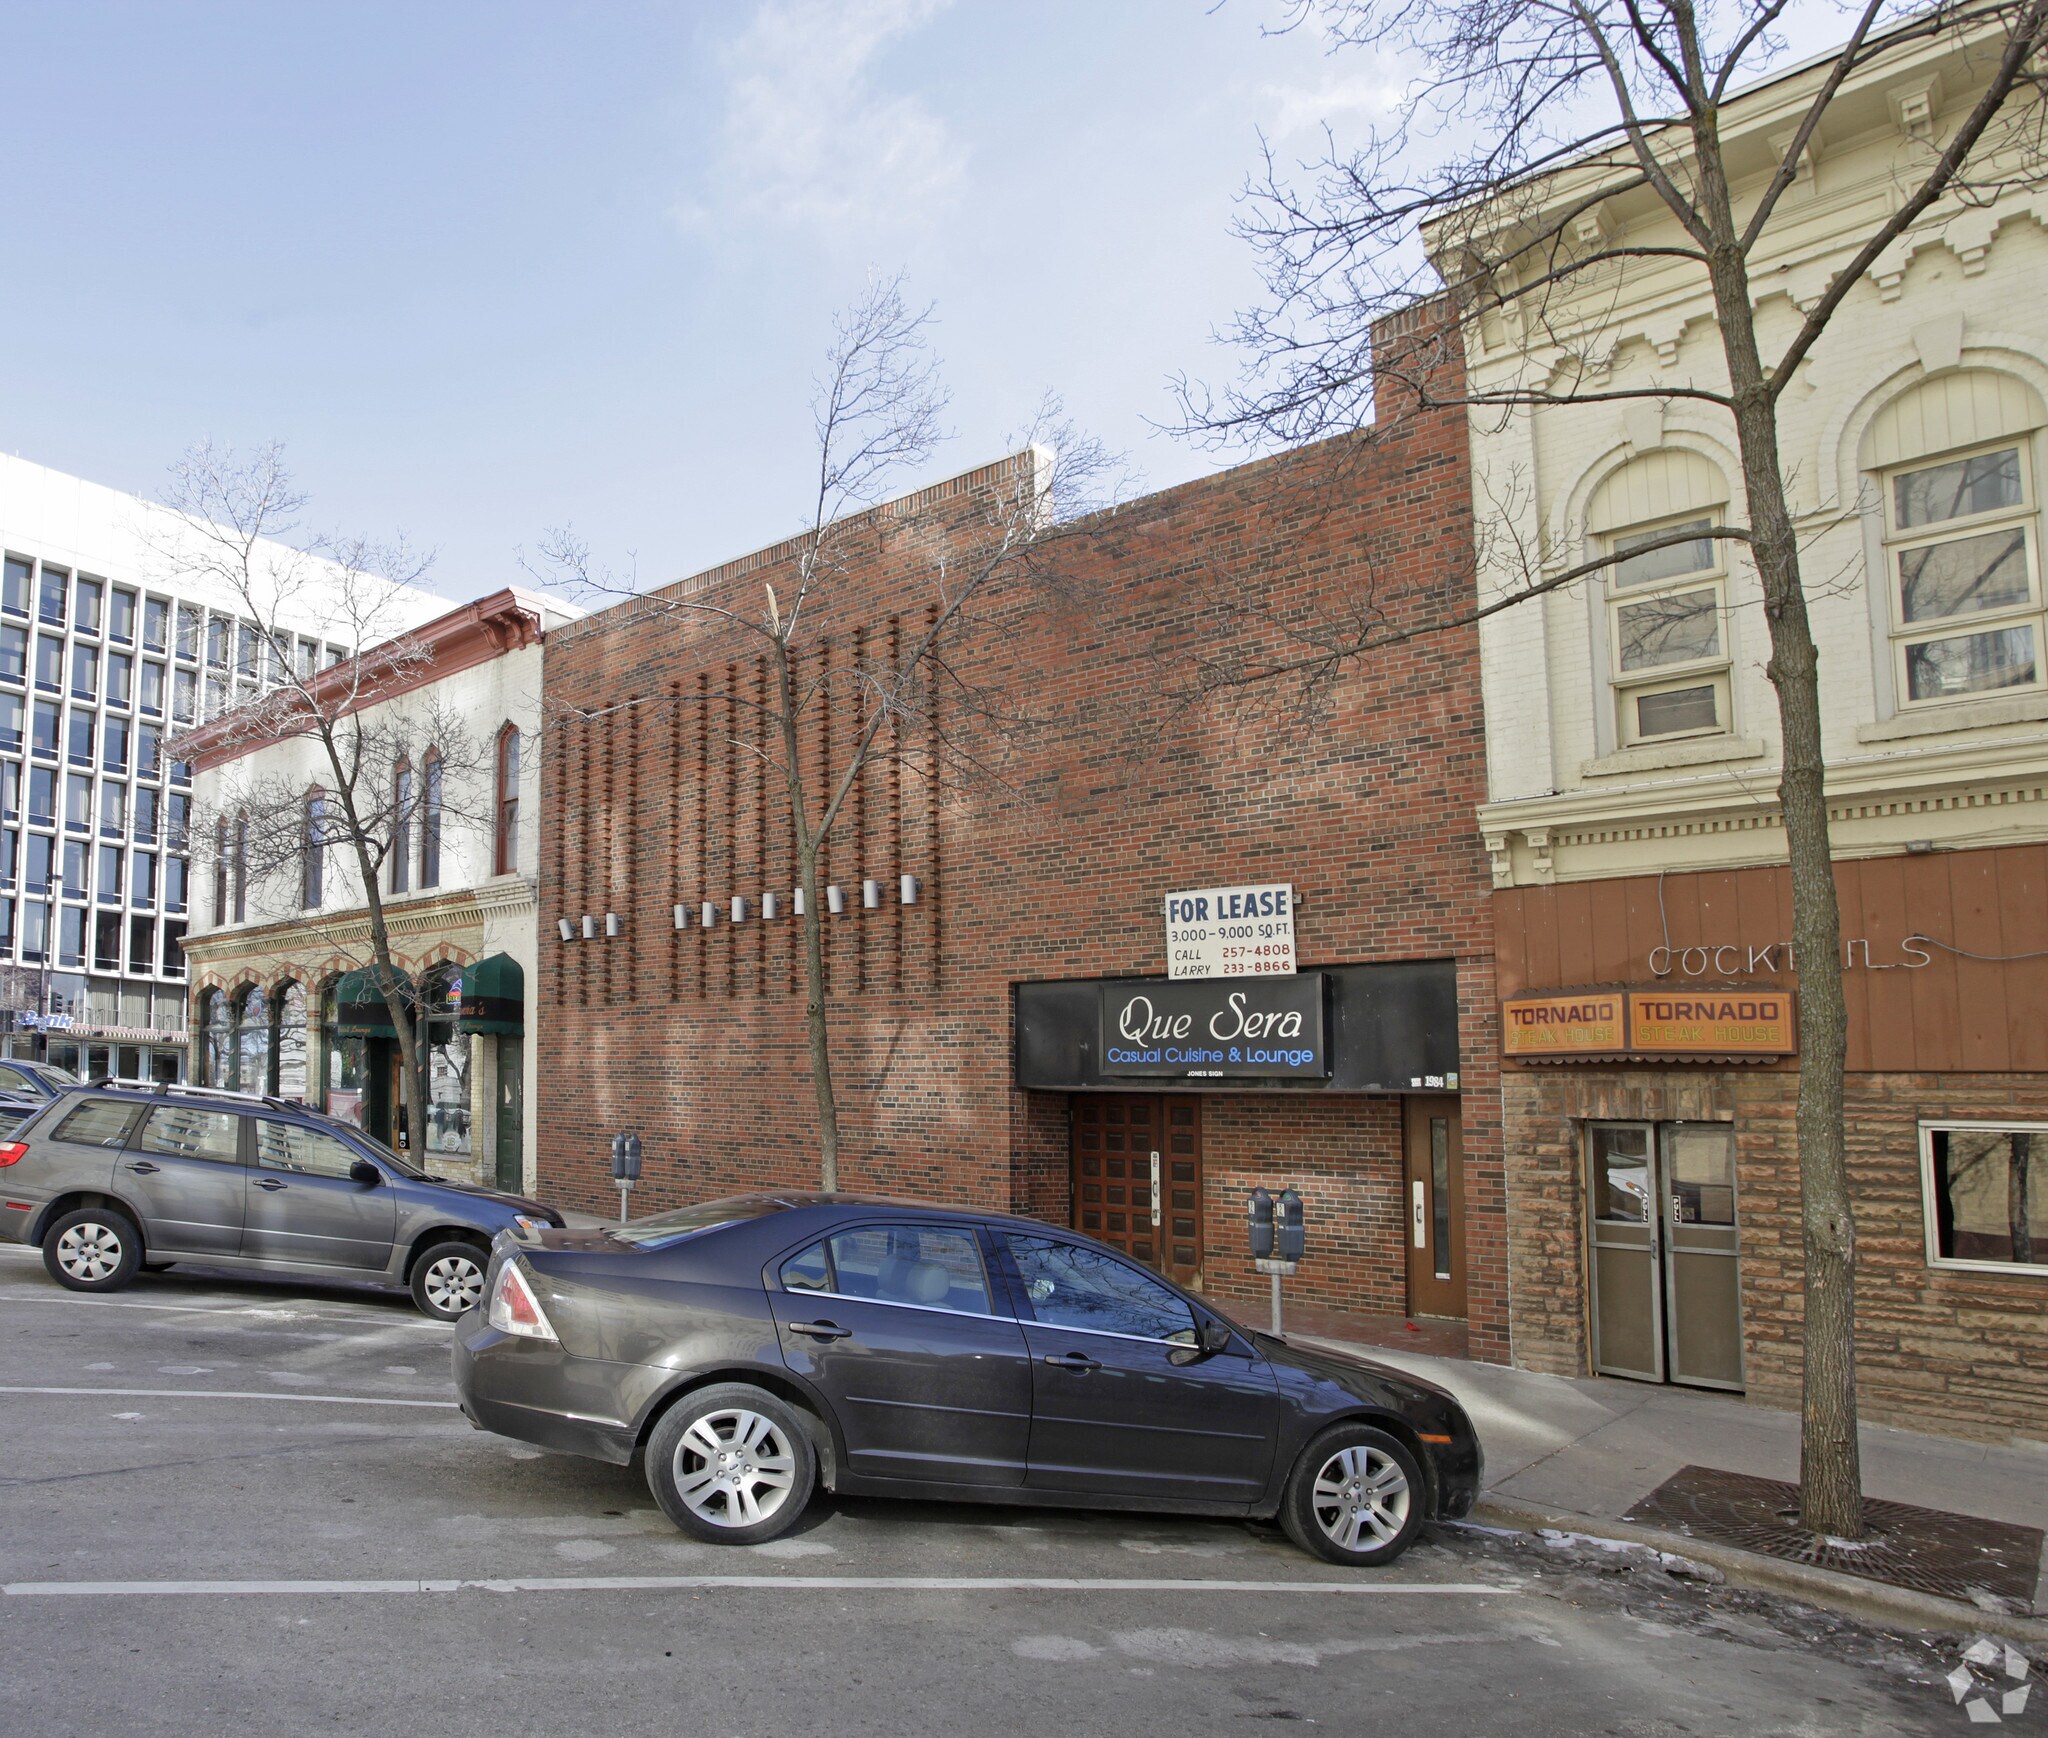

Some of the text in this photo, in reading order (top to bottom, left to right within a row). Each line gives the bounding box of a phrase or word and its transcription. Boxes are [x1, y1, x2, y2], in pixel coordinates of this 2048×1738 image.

[1169, 890, 1287, 923] FOR LEASE
[1174, 943, 1290, 961] CALL 257-4808
[1649, 936, 1931, 976] COCKTILS
[1174, 960, 1290, 977] LARRY 233-8866
[1119, 992, 1303, 1048] Que Sera
[1510, 1003, 1614, 1026] TORNADO
[1639, 1002, 1779, 1021] TORNADO
[1510, 1027, 1614, 1046] STEAK HOUSE
[1639, 1026, 1780, 1042] STEAK HOUSE
[1107, 1047, 1314, 1067] Casual Cuisine & Lounge
